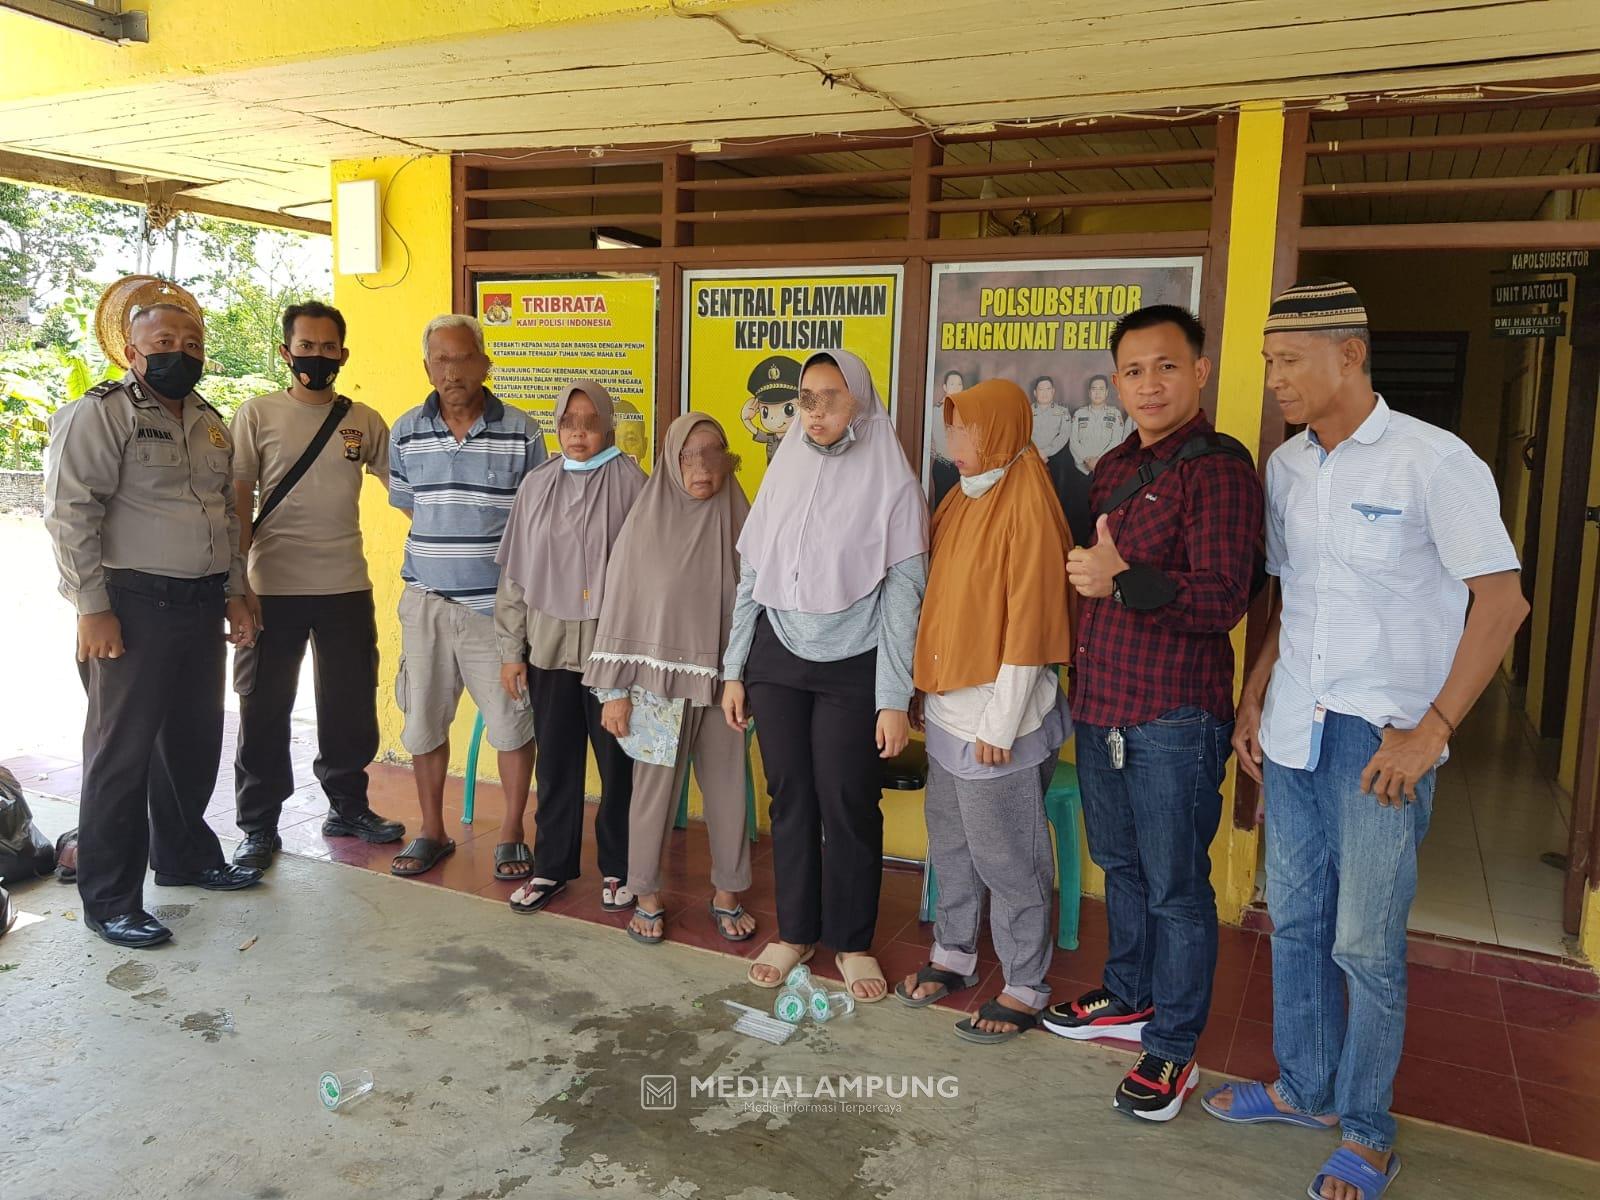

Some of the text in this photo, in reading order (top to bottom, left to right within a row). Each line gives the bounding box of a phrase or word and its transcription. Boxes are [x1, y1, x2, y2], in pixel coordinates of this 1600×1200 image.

[1511, 250, 1589, 270] KAPOLSUBSEKTOR
[697, 284, 888, 317] SENTRAL PELAYANAN
[979, 285, 1142, 317] POLSUBSEKTOR
[1496, 283, 1563, 303] UNIT PATROLI
[522, 295, 607, 313] TRIBRATA
[516, 318, 612, 327] KAMI POLISI INDONESIA
[1494, 316, 1561, 328] DWI HARYANTO
[734, 319, 844, 350] KEPOLISIAN
[941, 322, 1059, 351] BENGKUNAT
